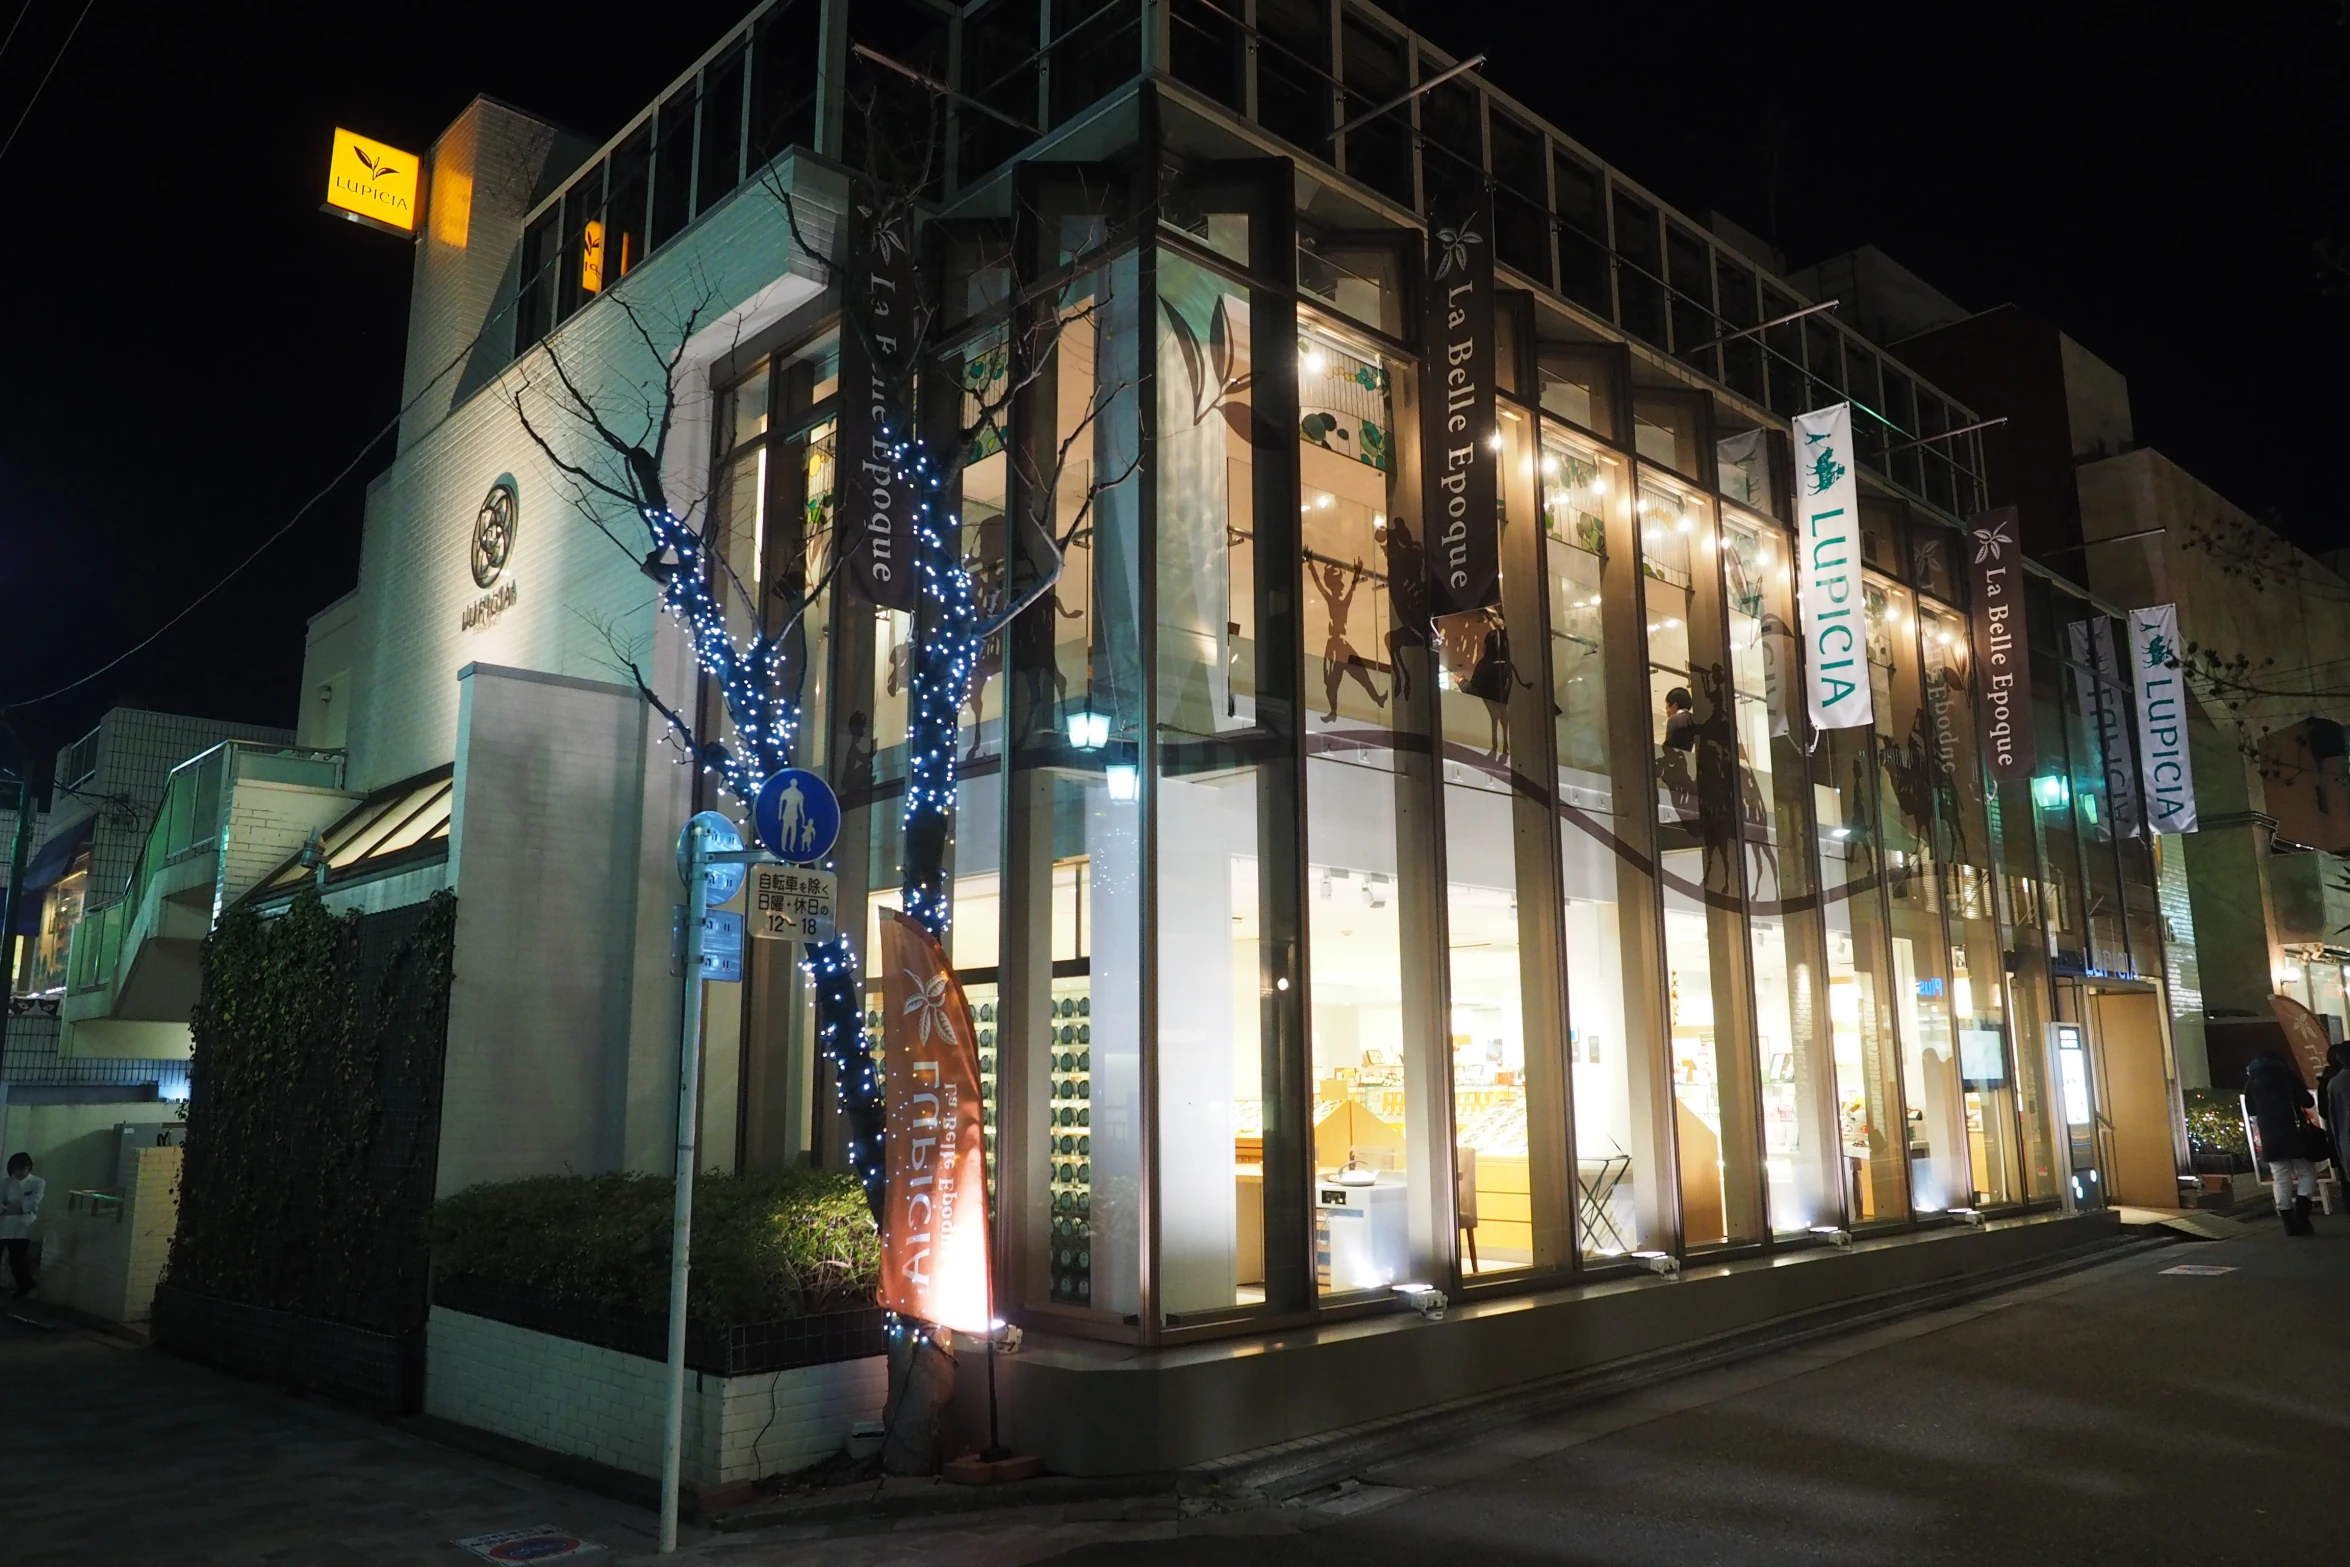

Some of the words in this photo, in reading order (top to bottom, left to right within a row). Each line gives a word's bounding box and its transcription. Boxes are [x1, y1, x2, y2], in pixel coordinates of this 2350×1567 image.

[336, 175, 408, 211] LUPICIA
[1447, 279, 1474, 329] La
[1447, 337, 1476, 433] Belle
[862, 437, 894, 584] Epoque
[1440, 441, 1475, 590] Epoque
[461, 578, 518, 632] LUPICIA
[1810, 508, 1857, 708] LUPICIA
[1986, 566, 2007, 598] La
[1986, 603, 2010, 666] Belle
[1988, 672, 2016, 767] Epoque
[2145, 678, 2185, 819] LUPICIA
[758, 872, 829, 896] 自転車を除く
[758, 894, 830, 916] 日曜・休日の
[2083, 946, 2140, 981] LUPICIA
